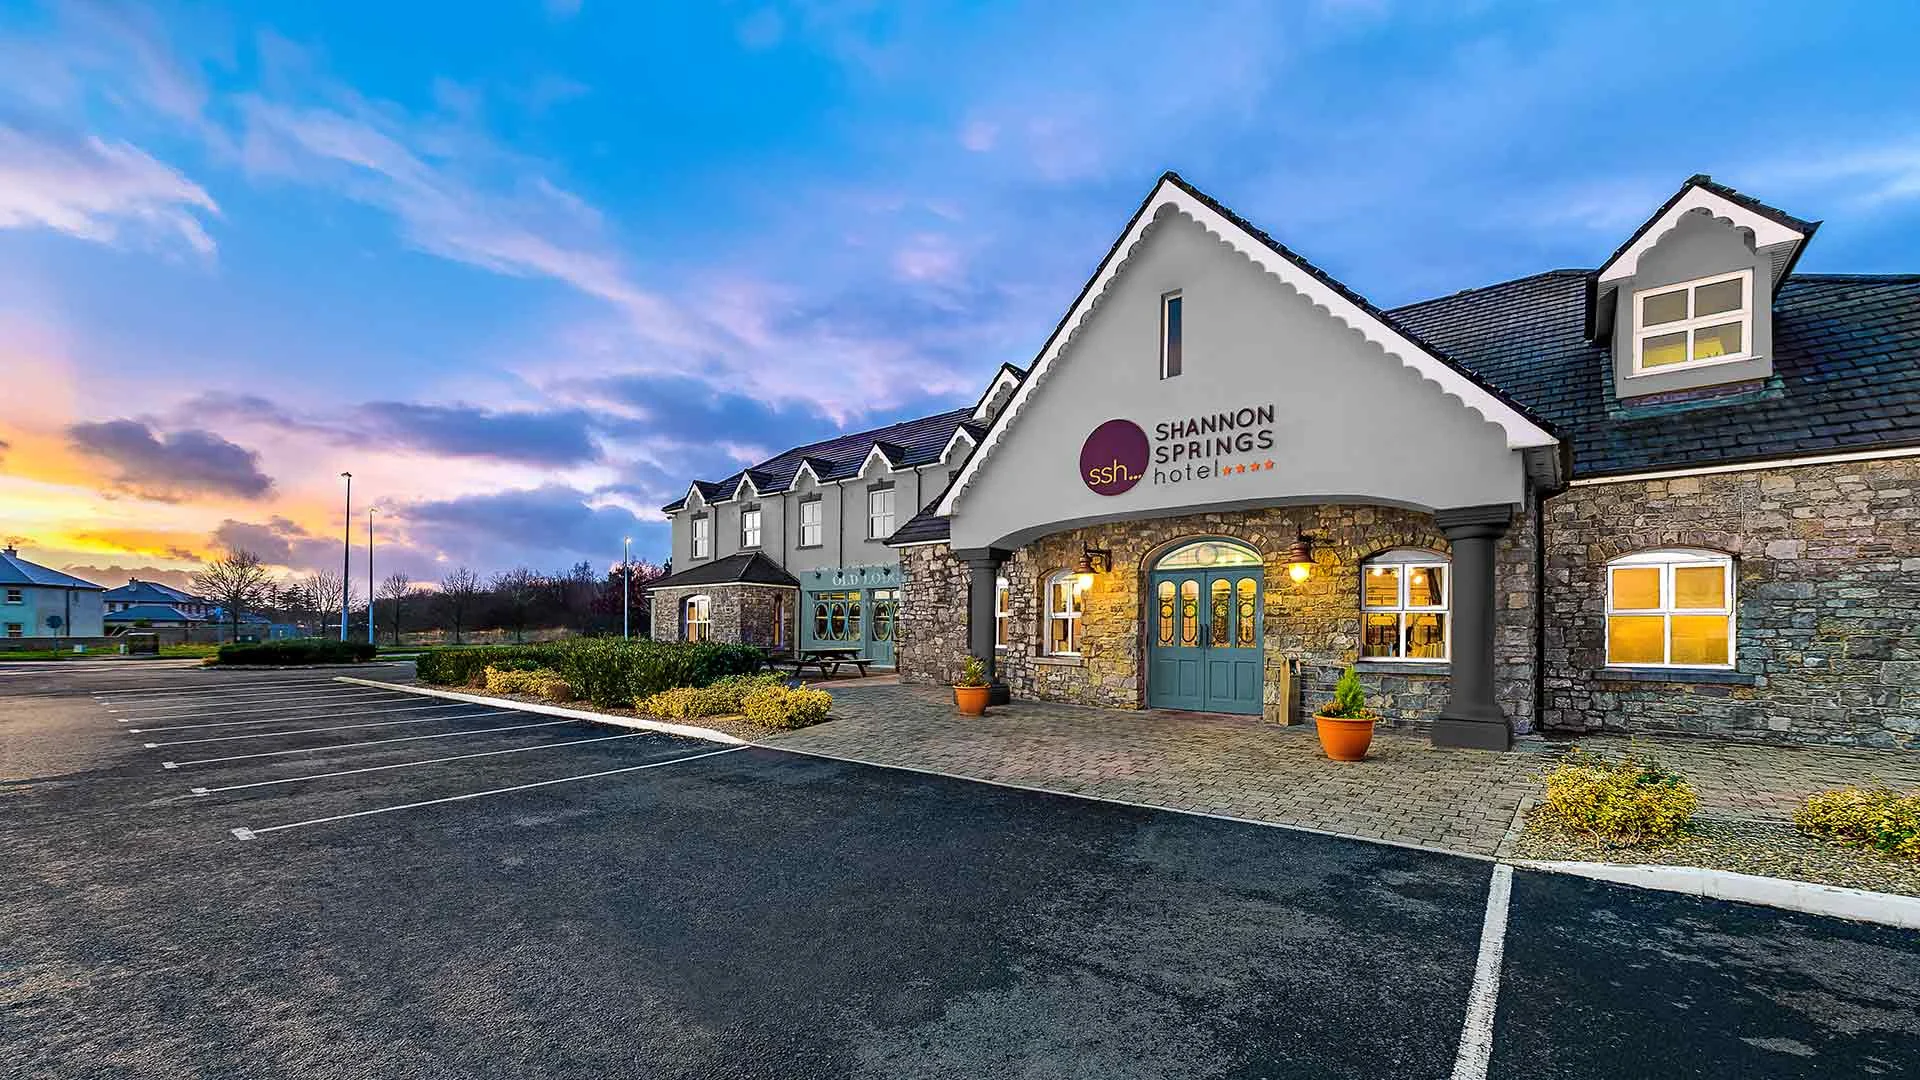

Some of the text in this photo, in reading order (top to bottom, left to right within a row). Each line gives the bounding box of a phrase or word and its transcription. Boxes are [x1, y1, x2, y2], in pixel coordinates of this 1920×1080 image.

[1154, 404, 1275, 442] SHANNON
[1155, 430, 1274, 464] SPRINGS
[1153, 459, 1219, 485] hotel
[832, 574, 859, 586] OLD
